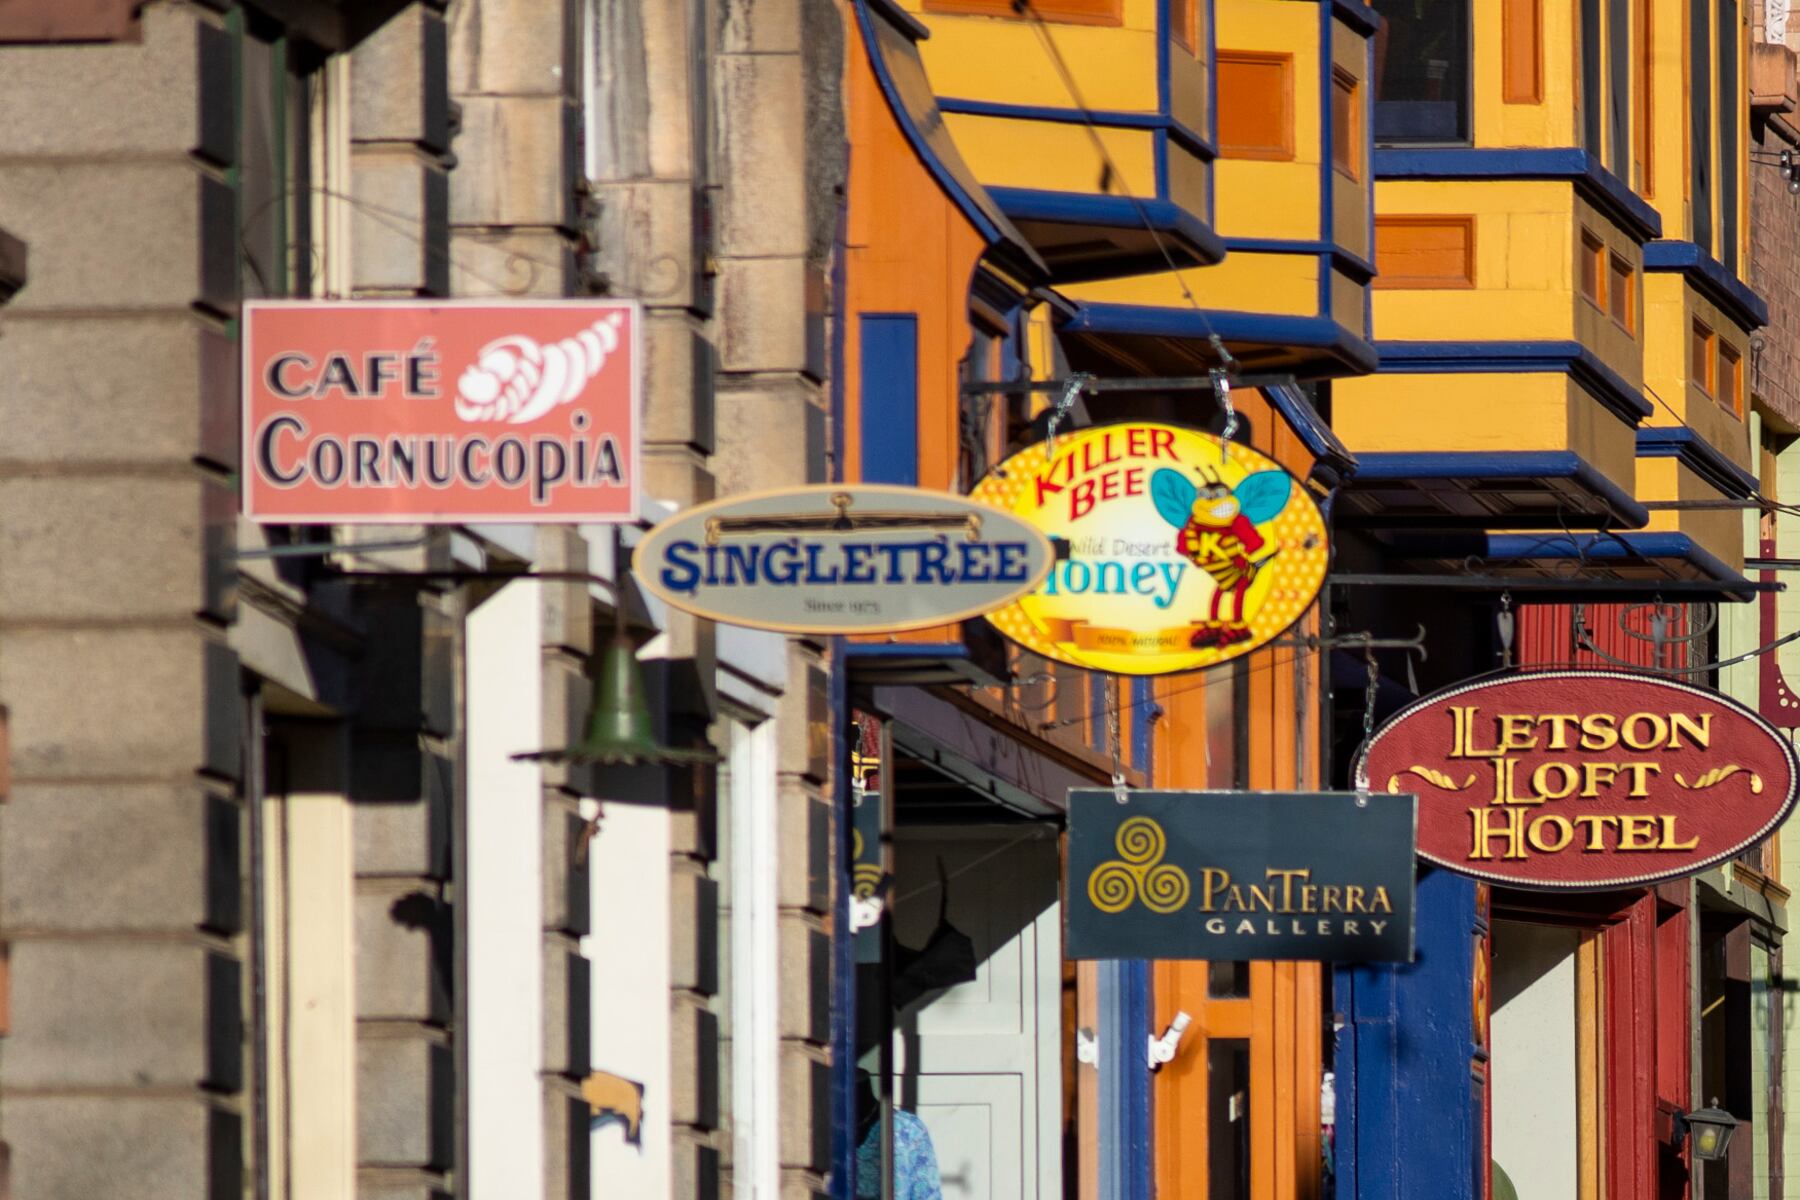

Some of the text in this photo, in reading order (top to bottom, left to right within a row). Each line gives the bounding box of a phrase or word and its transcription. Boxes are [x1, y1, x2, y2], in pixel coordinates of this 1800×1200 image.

[263, 337, 442, 399] CAFÉ
[1034, 428, 1181, 508] KILLER
[1068, 467, 1144, 522] BEE
[659, 534, 1030, 598] SINGLETREE
[1113, 538, 1171, 557] Desert
[1448, 705, 1715, 758] LETSON
[1492, 756, 1662, 806] LOFT
[1468, 804, 1700, 861] HOTEL
[1206, 917, 1389, 937] GALLERY
